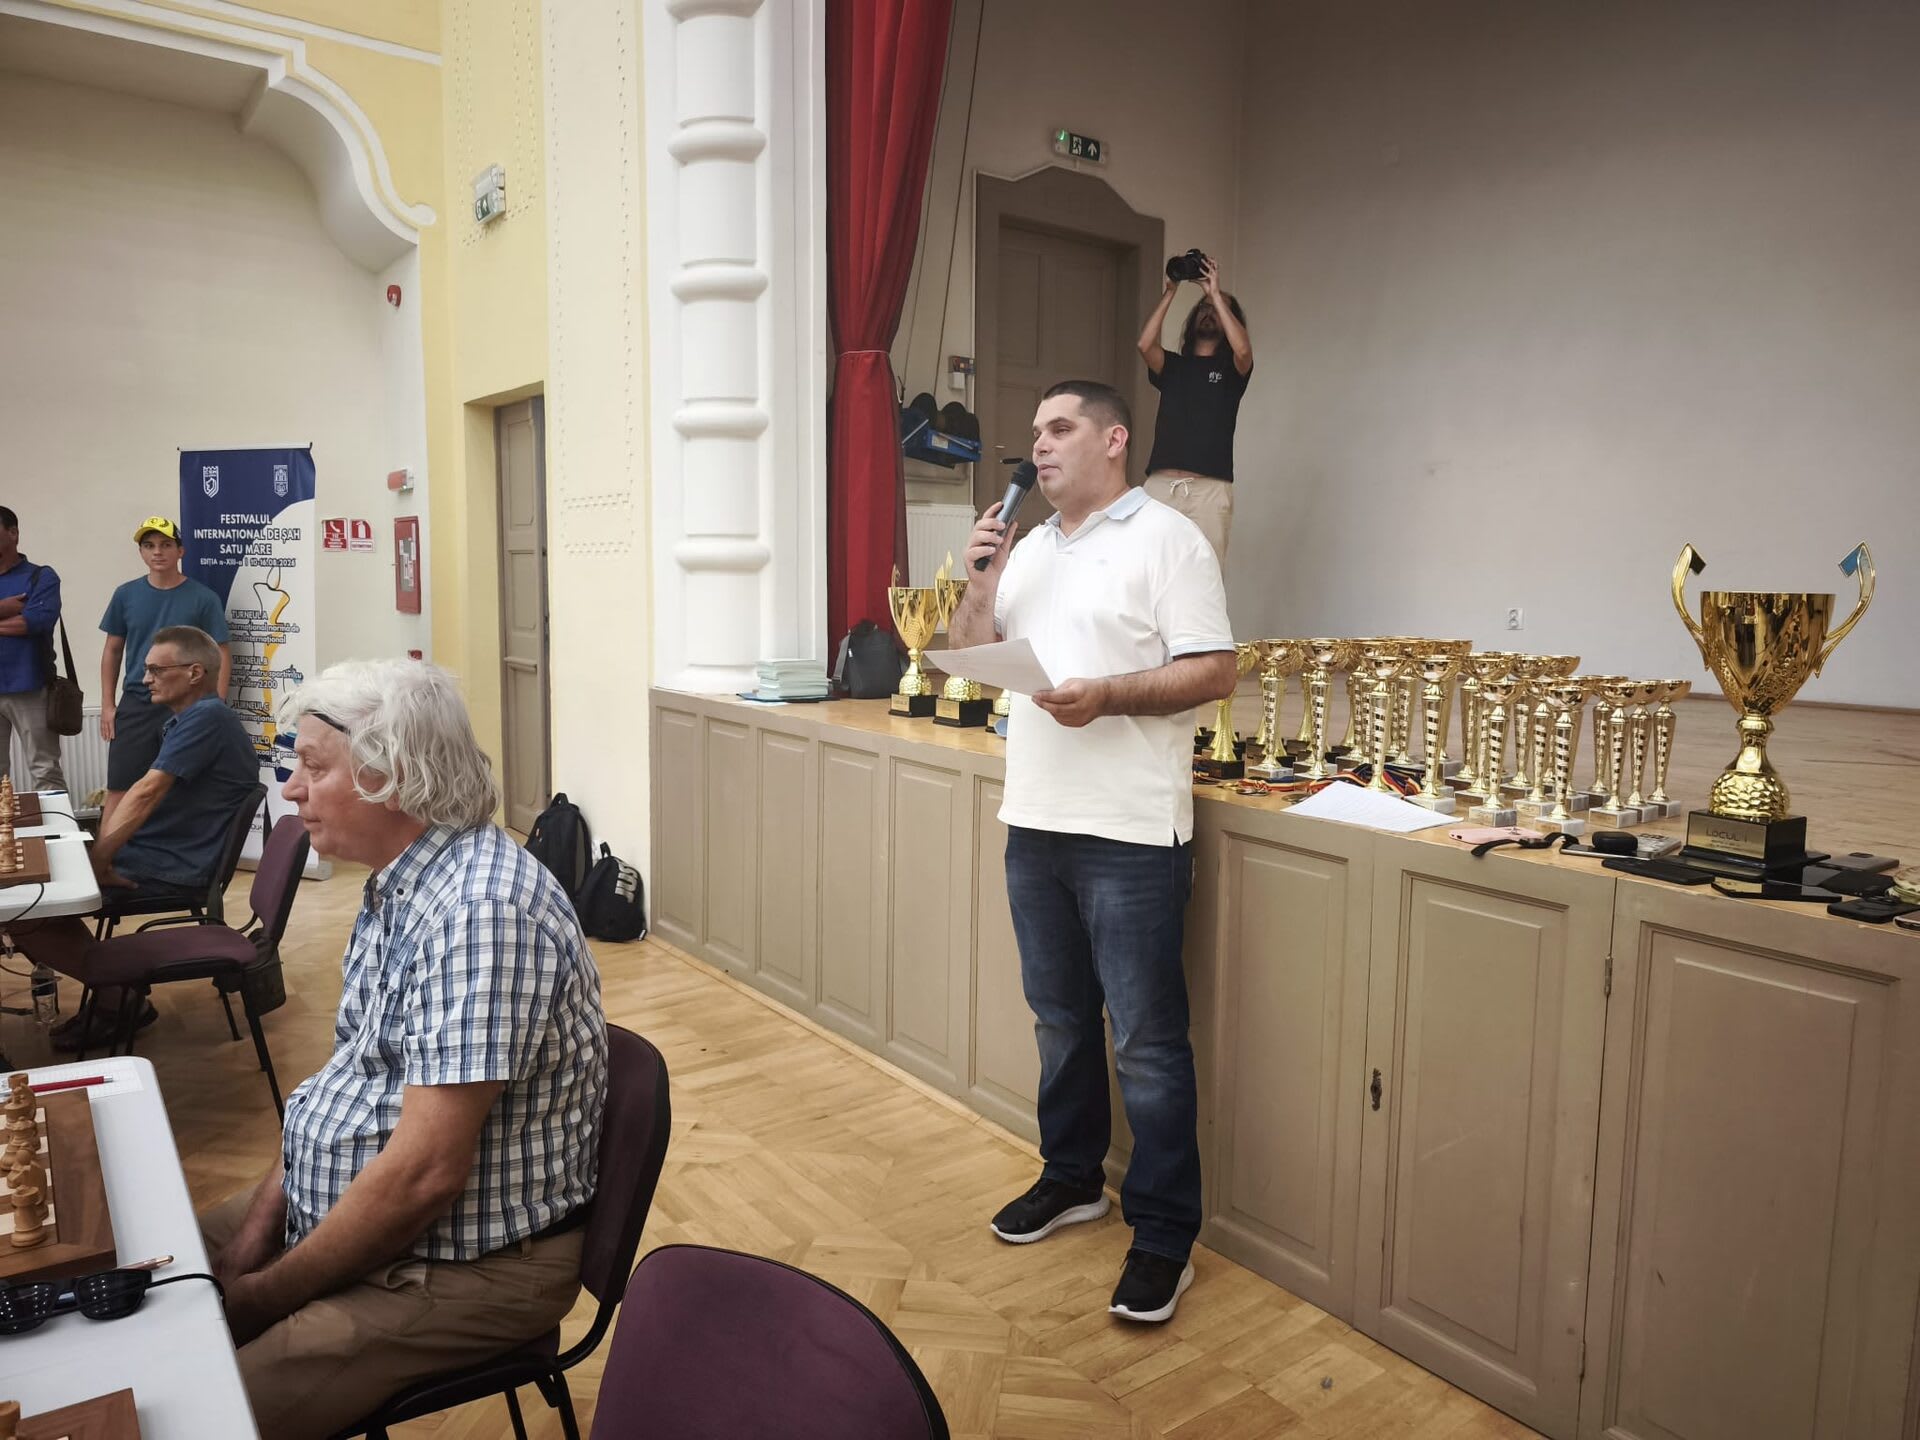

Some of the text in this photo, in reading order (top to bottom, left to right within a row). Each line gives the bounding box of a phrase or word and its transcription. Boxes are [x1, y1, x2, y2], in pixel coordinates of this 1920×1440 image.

[220, 513, 272, 525] FESTIVALUL
[266, 528, 280, 540] DE
[220, 543, 272, 555] SATU MARE
[231, 609, 268, 620] TURNEUL A
[231, 655, 263, 666] TURNEUL
[258, 679, 278, 689] 2200
